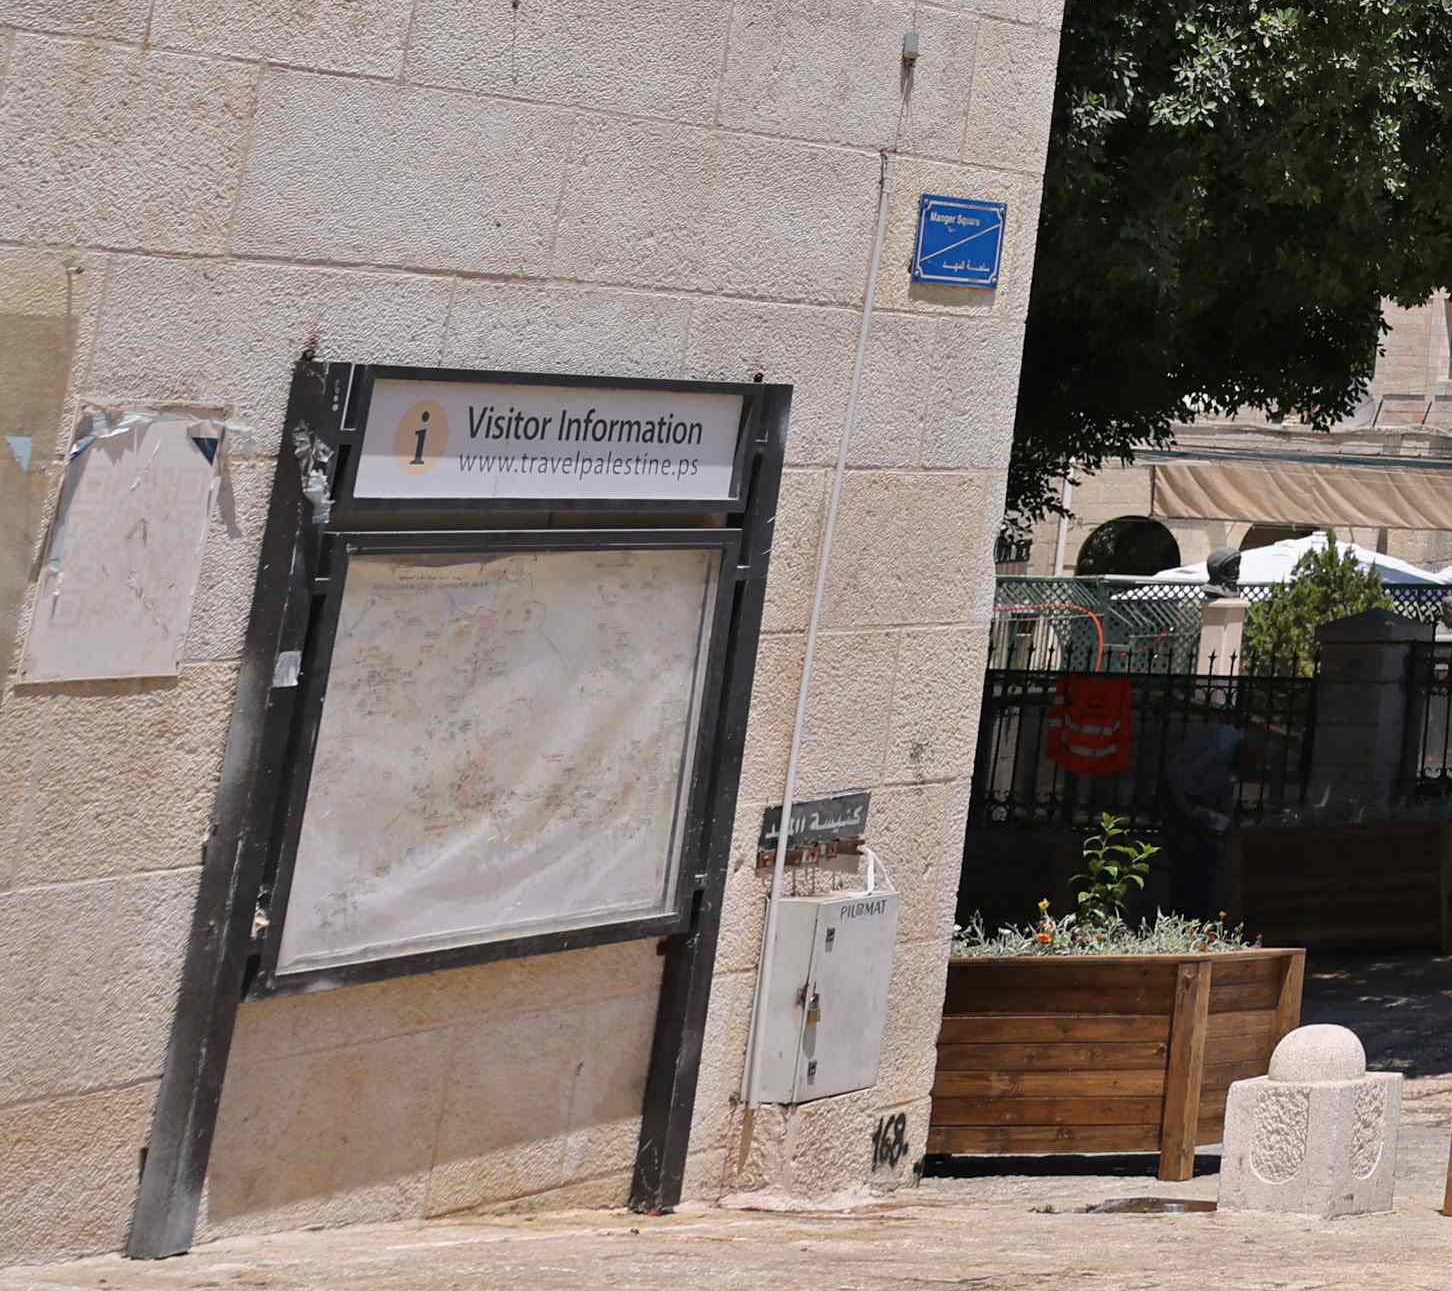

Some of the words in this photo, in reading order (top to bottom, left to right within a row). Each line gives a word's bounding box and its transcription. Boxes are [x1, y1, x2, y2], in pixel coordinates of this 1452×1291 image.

[468, 406, 551, 440] Visitor
[558, 408, 703, 445] Information
[459, 451, 699, 481] www.travelpalestine.ps
